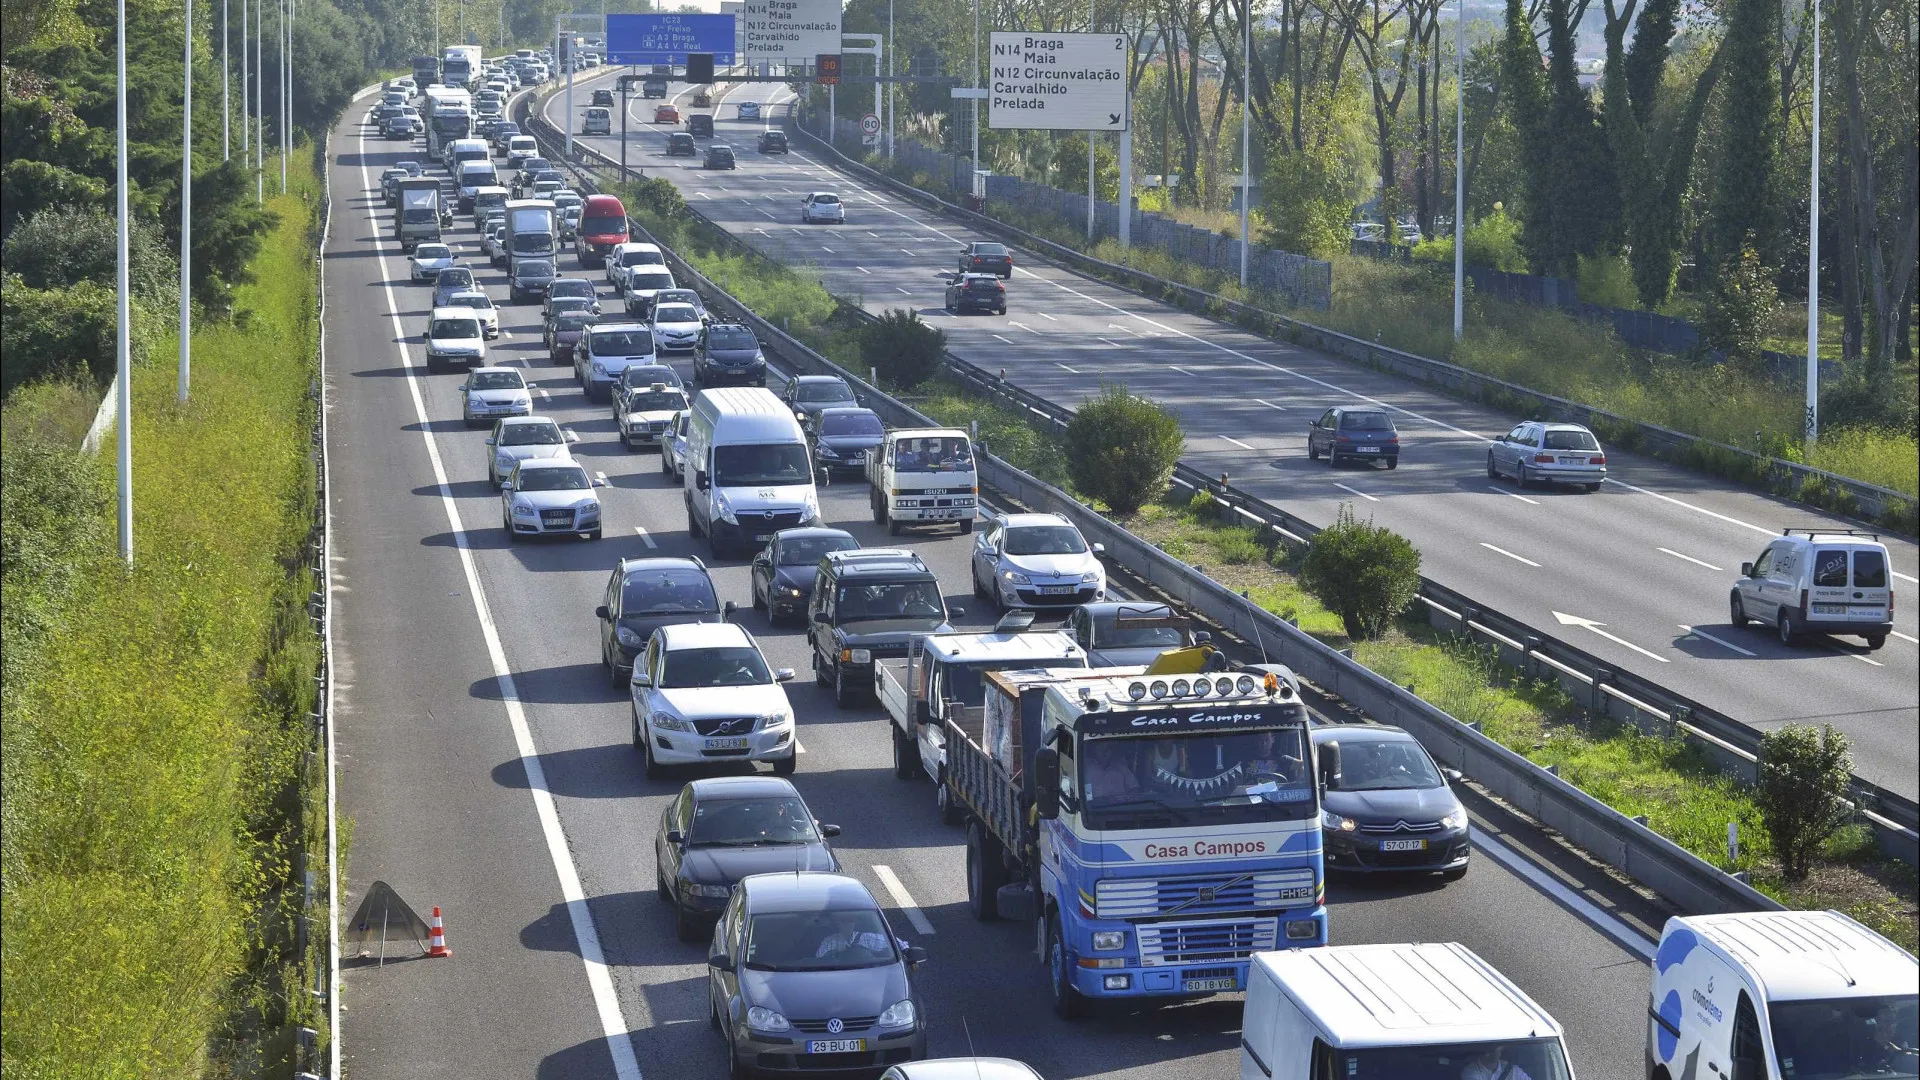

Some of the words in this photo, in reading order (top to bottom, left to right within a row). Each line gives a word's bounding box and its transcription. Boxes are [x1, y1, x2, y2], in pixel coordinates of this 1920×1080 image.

[748, 6, 767, 14] N14
[769, 1, 797, 11] Braga
[769, 11, 792, 19] Maia
[748, 22, 766, 30] N12
[769, 22, 837, 32] Circunvalação
[672, 34, 695, 42] Braga
[748, 33, 800, 41] Carvalhido
[748, 43, 784, 51] Prelada
[1024, 37, 1064, 50] Braga
[1115, 38, 1123, 50] 2
[994, 44, 1021, 55] N14
[1024, 52, 1056, 64] Maia
[994, 67, 1020, 78] N12
[1024, 68, 1120, 82] Circunvalação
[994, 82, 1067, 94] Carvalhido
[993, 97, 1045, 109] Prelada
[864, 120, 878, 129] 80
[1131, 716, 1178, 726] Casa
[1188, 712, 1261, 723] Campos
[1277, 790, 1310, 801] CAMPOS
[1144, 843, 1188, 859] Casa
[1194, 841, 1266, 858] Campos
[1280, 888, 1308, 899] FH12
